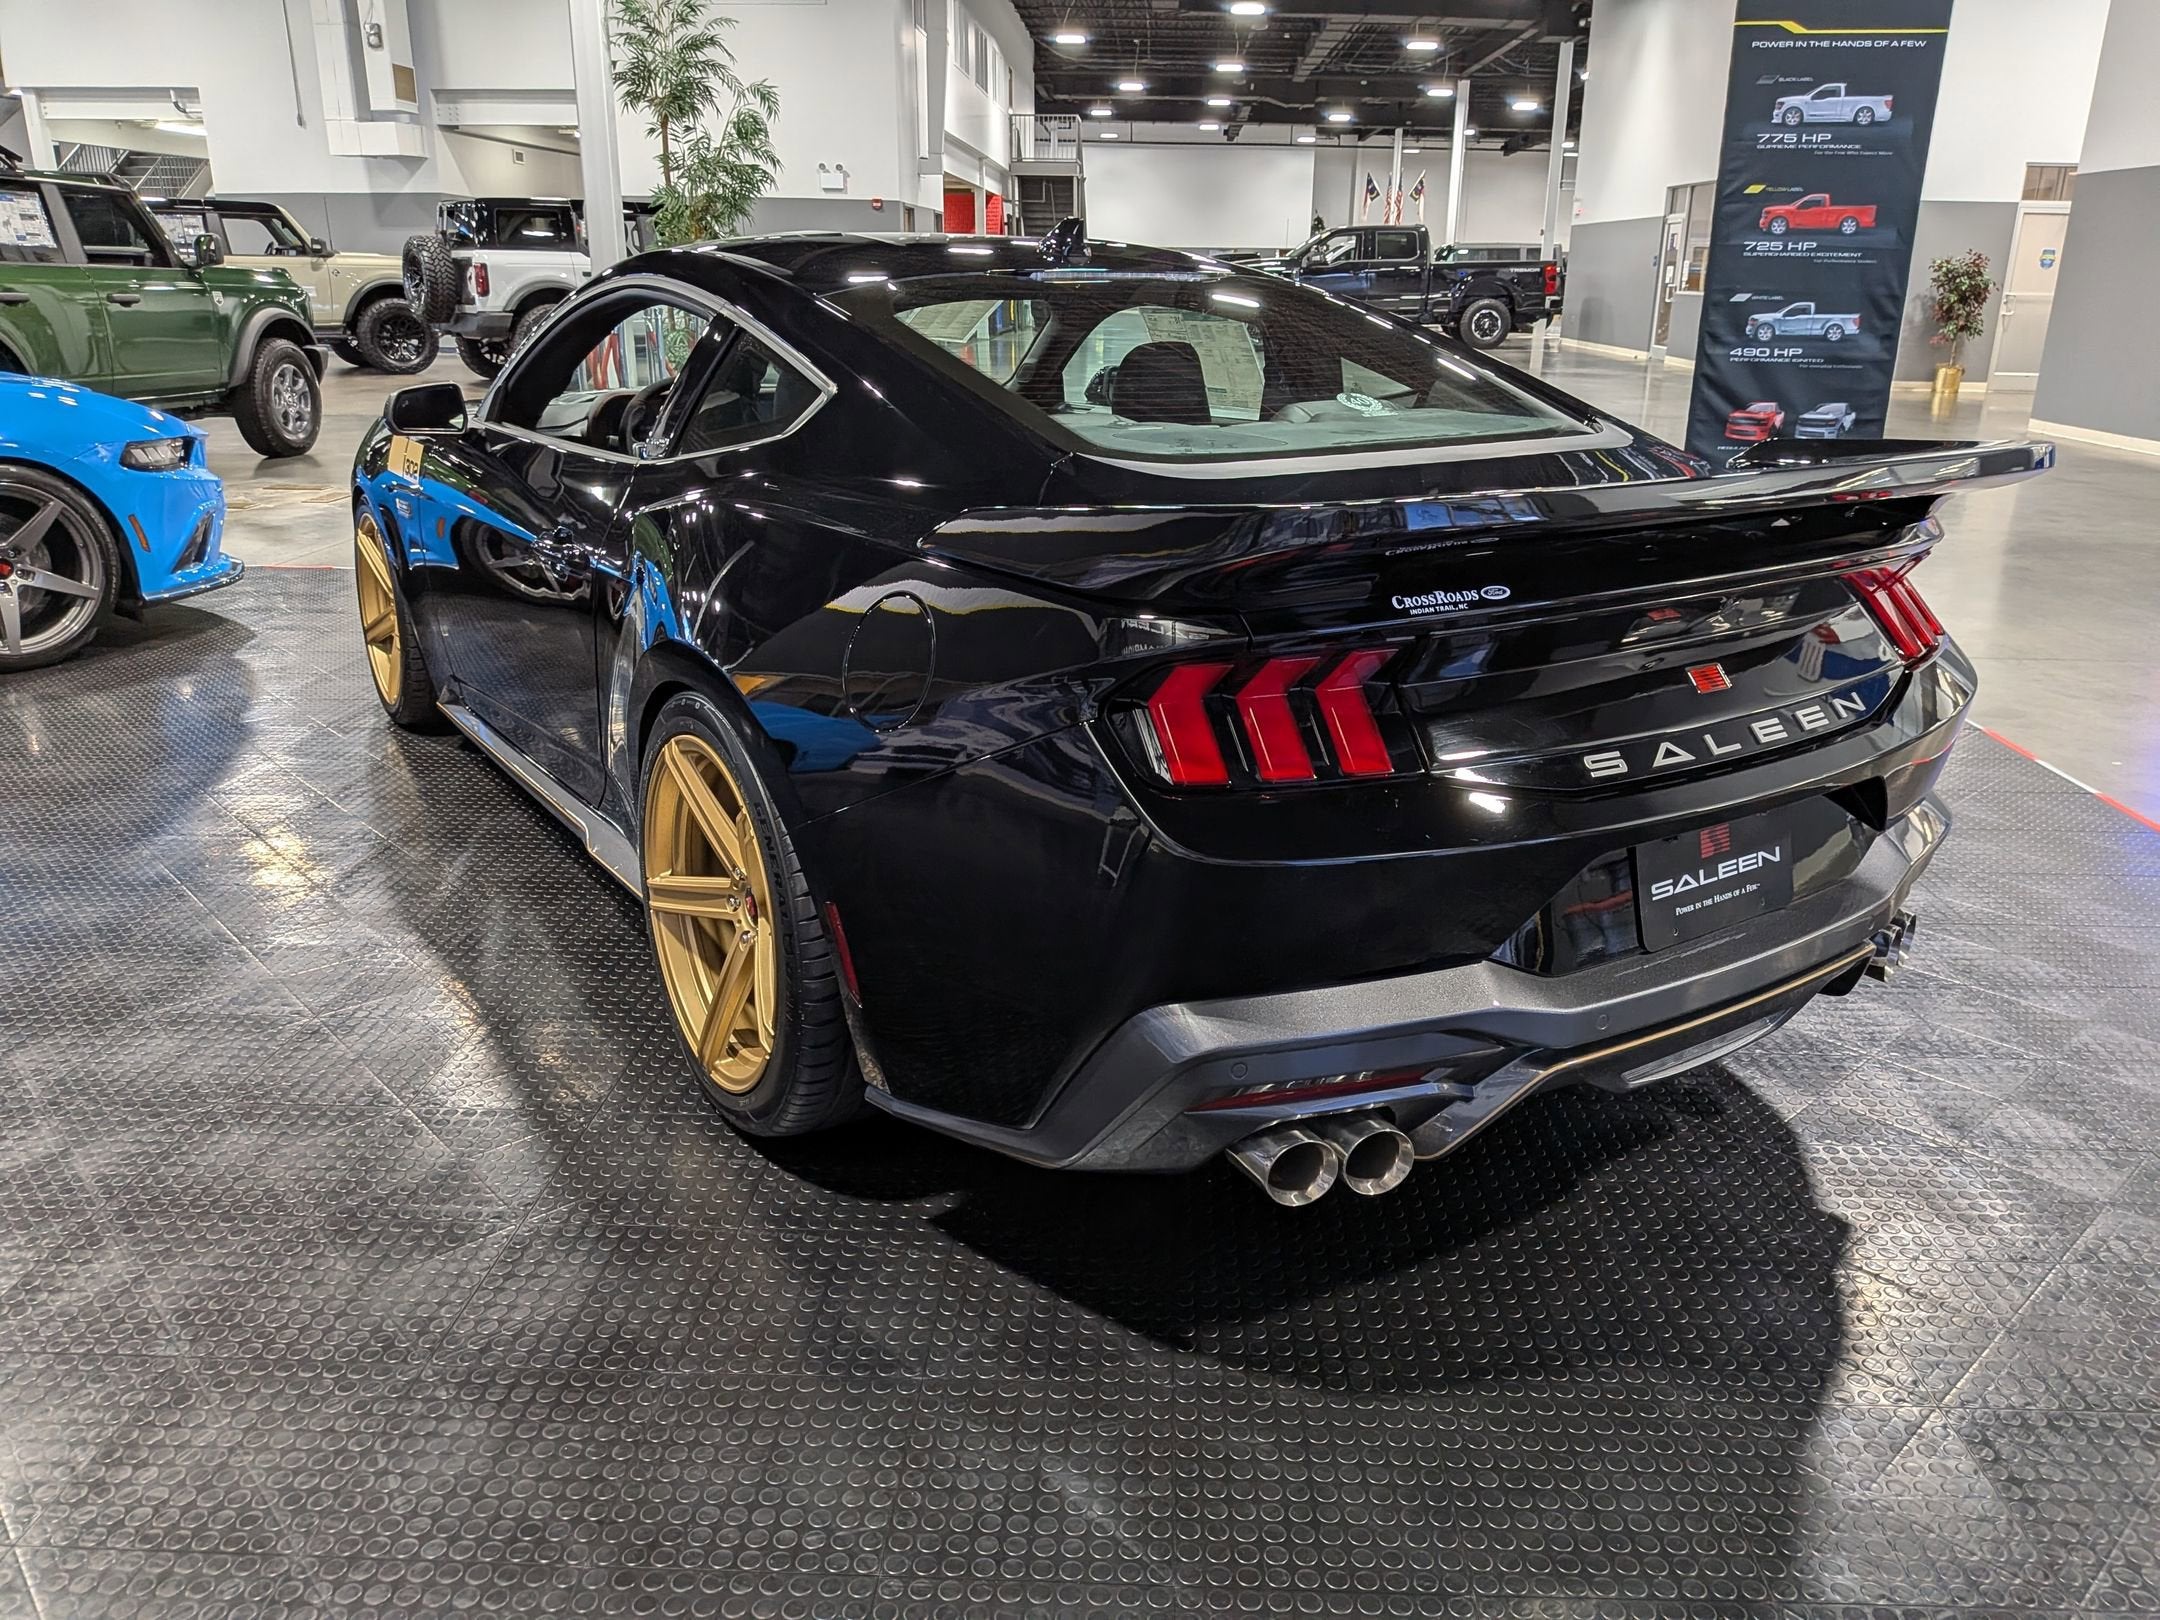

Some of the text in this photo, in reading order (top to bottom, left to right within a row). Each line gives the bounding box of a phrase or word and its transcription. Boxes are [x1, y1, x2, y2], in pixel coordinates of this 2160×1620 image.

[1757, 133, 1832, 143] 775 HP
[1743, 241, 1817, 251] 725 HP
[1729, 348, 1803, 357] 490 HP
[1410, 606, 1435, 615] INDIAN
[1583, 691, 1867, 778] SALEEN
[1651, 846, 1781, 901] SALEEN
